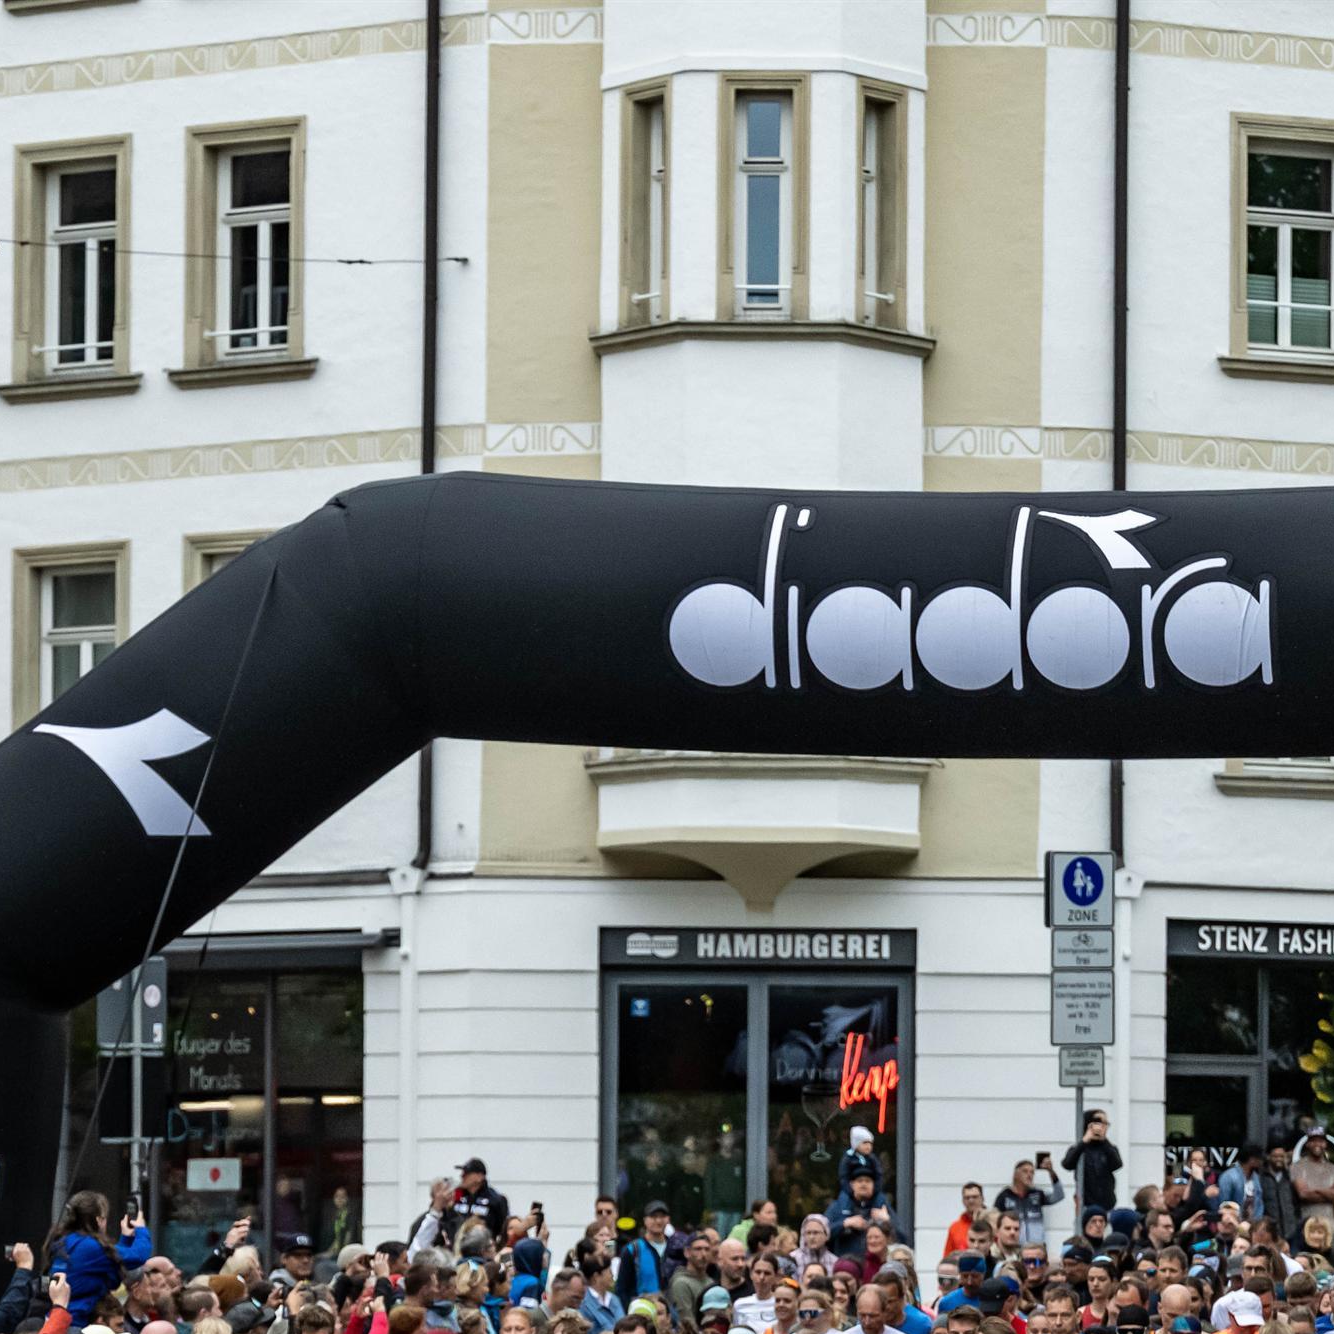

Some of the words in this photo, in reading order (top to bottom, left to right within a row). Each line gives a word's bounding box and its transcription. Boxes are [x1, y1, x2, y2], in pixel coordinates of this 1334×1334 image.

[670, 504, 1273, 690] diadora
[1068, 909, 1098, 921] ZONE
[697, 933, 891, 959] HAMBURGEREI
[1198, 925, 1268, 953] STENZ
